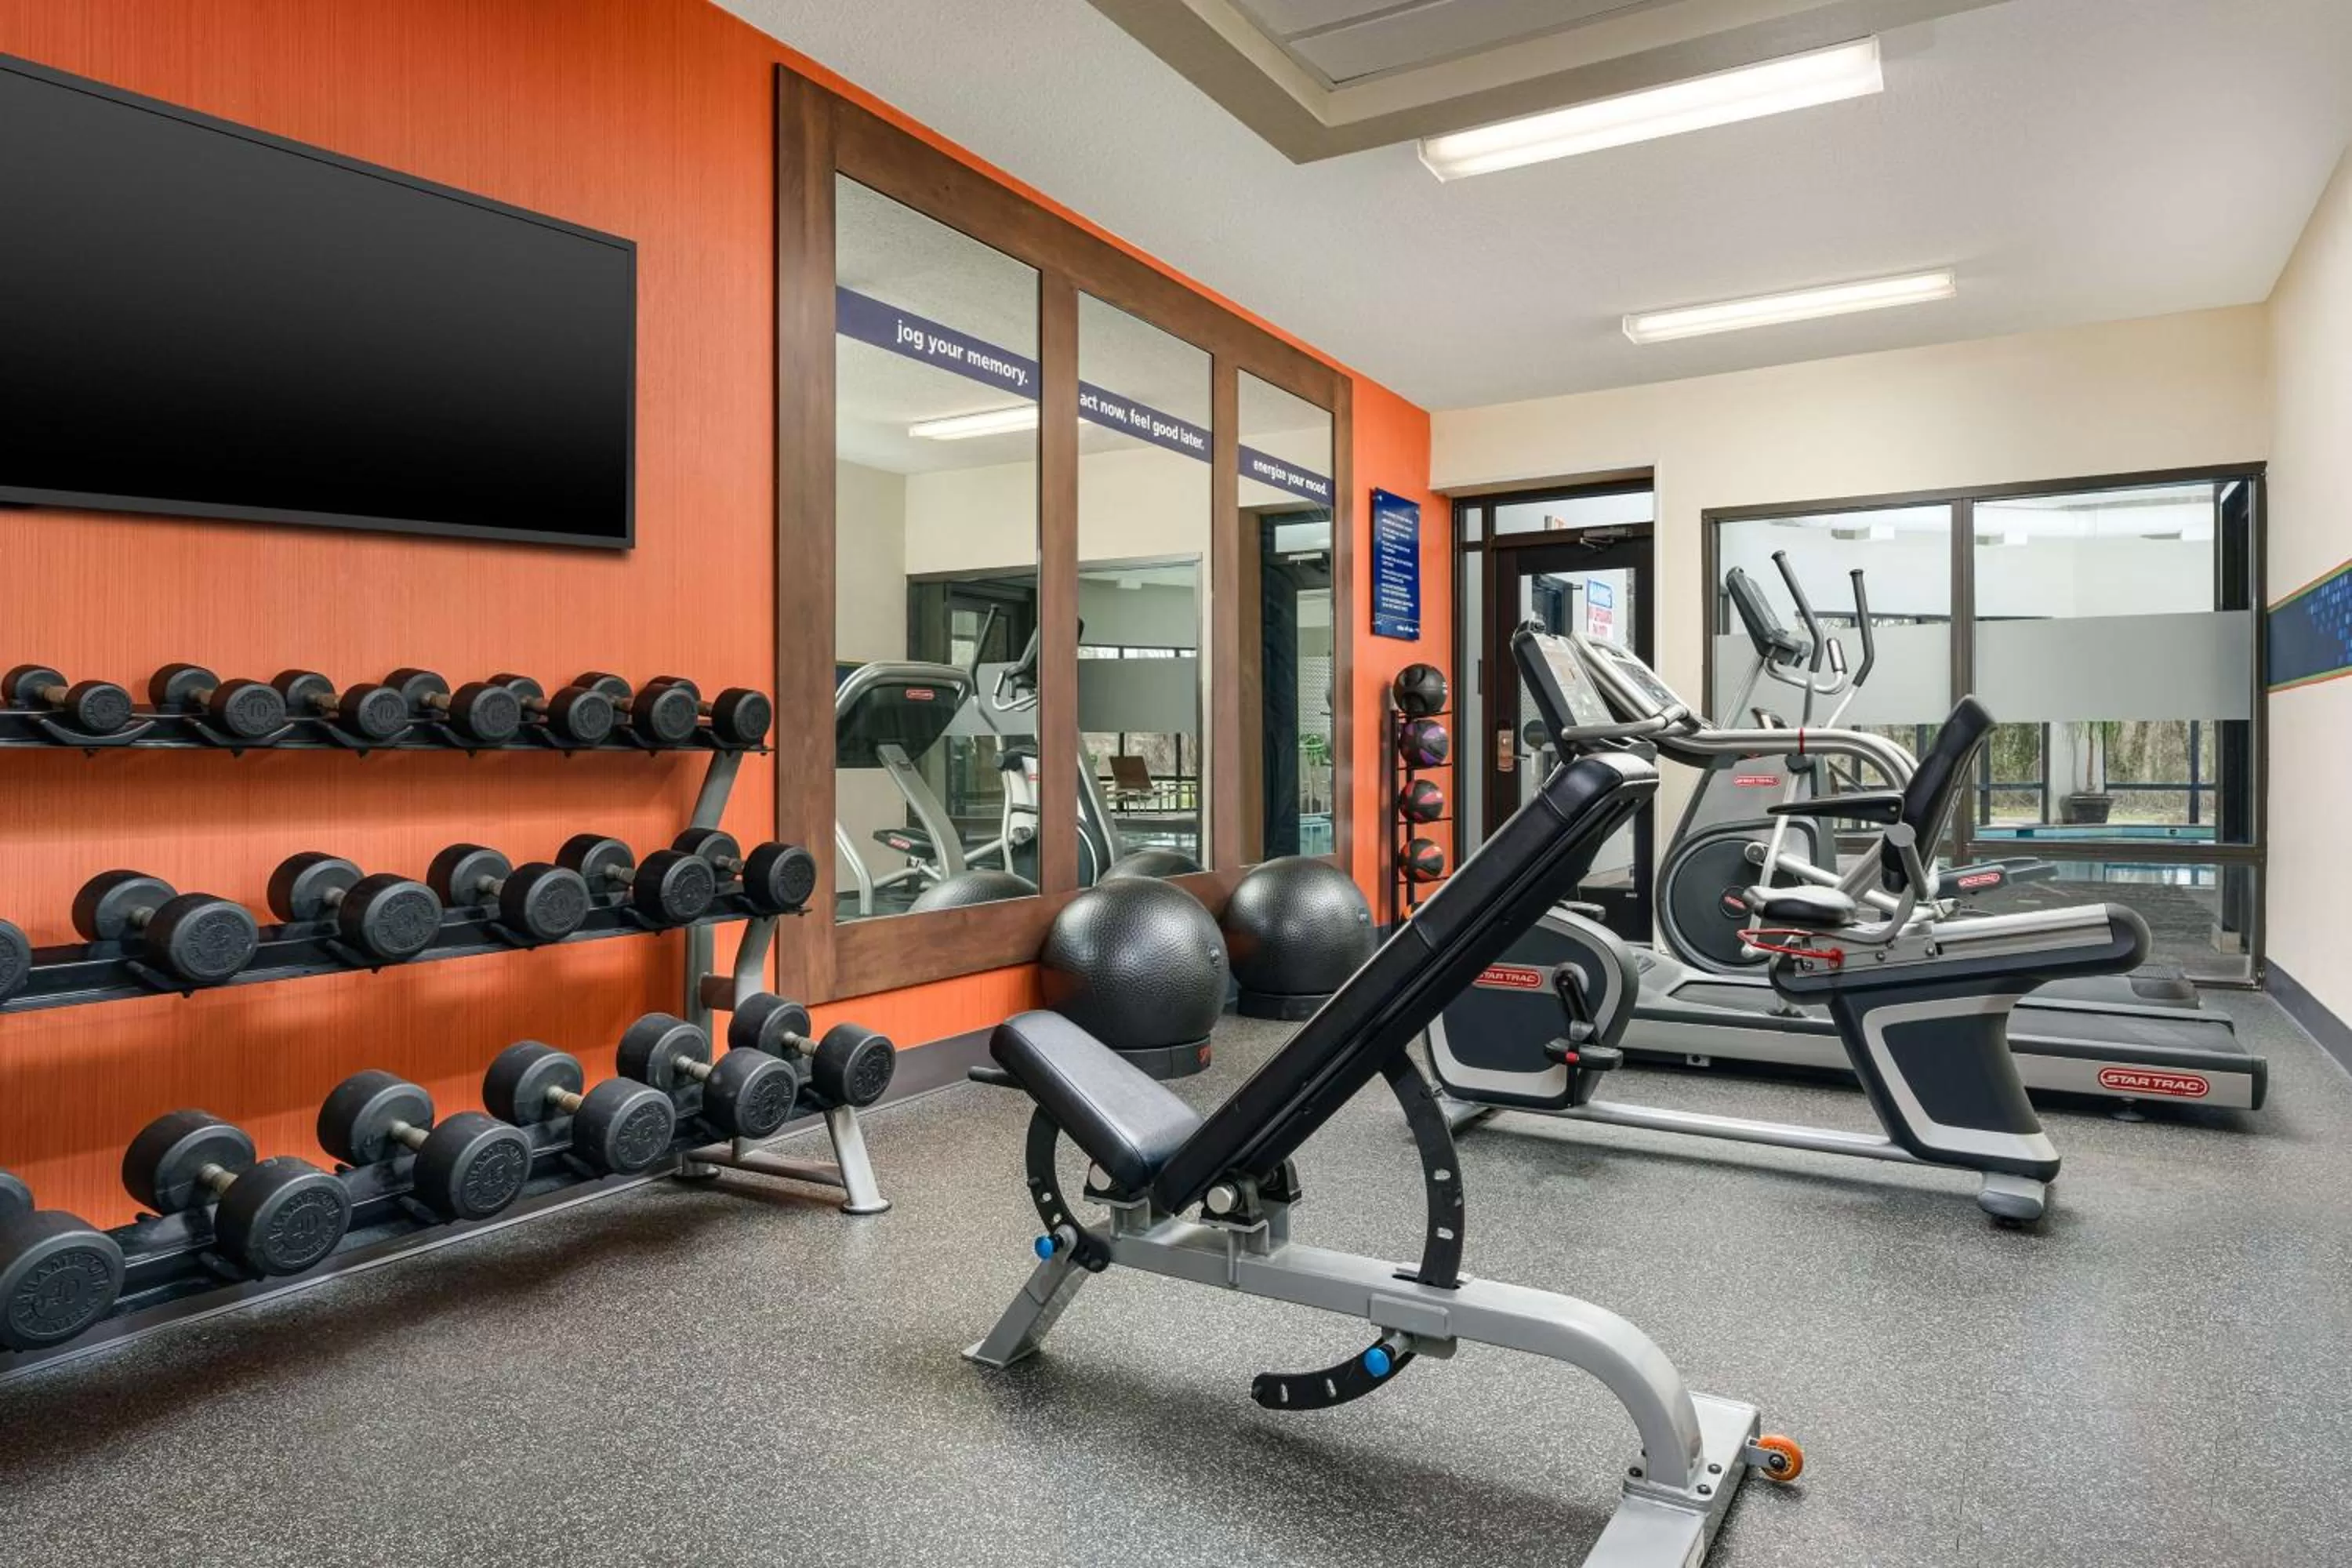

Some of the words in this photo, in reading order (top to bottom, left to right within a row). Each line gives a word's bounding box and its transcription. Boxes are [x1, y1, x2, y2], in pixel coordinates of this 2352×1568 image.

[897, 320, 924, 350] jog
[928, 336, 964, 360] your
[967, 350, 1029, 386] memory.
[1080, 394, 1098, 412] act
[1100, 401, 1127, 423] now,
[1130, 408, 1150, 430] feel
[1152, 421, 1178, 440] good
[1181, 428, 1205, 449] later.
[1287, 473, 1305, 487] your
[1505, 974, 1537, 982] TRAC
[2107, 1074, 2150, 1086] STAR
[2152, 1078, 2199, 1091] TRAC
